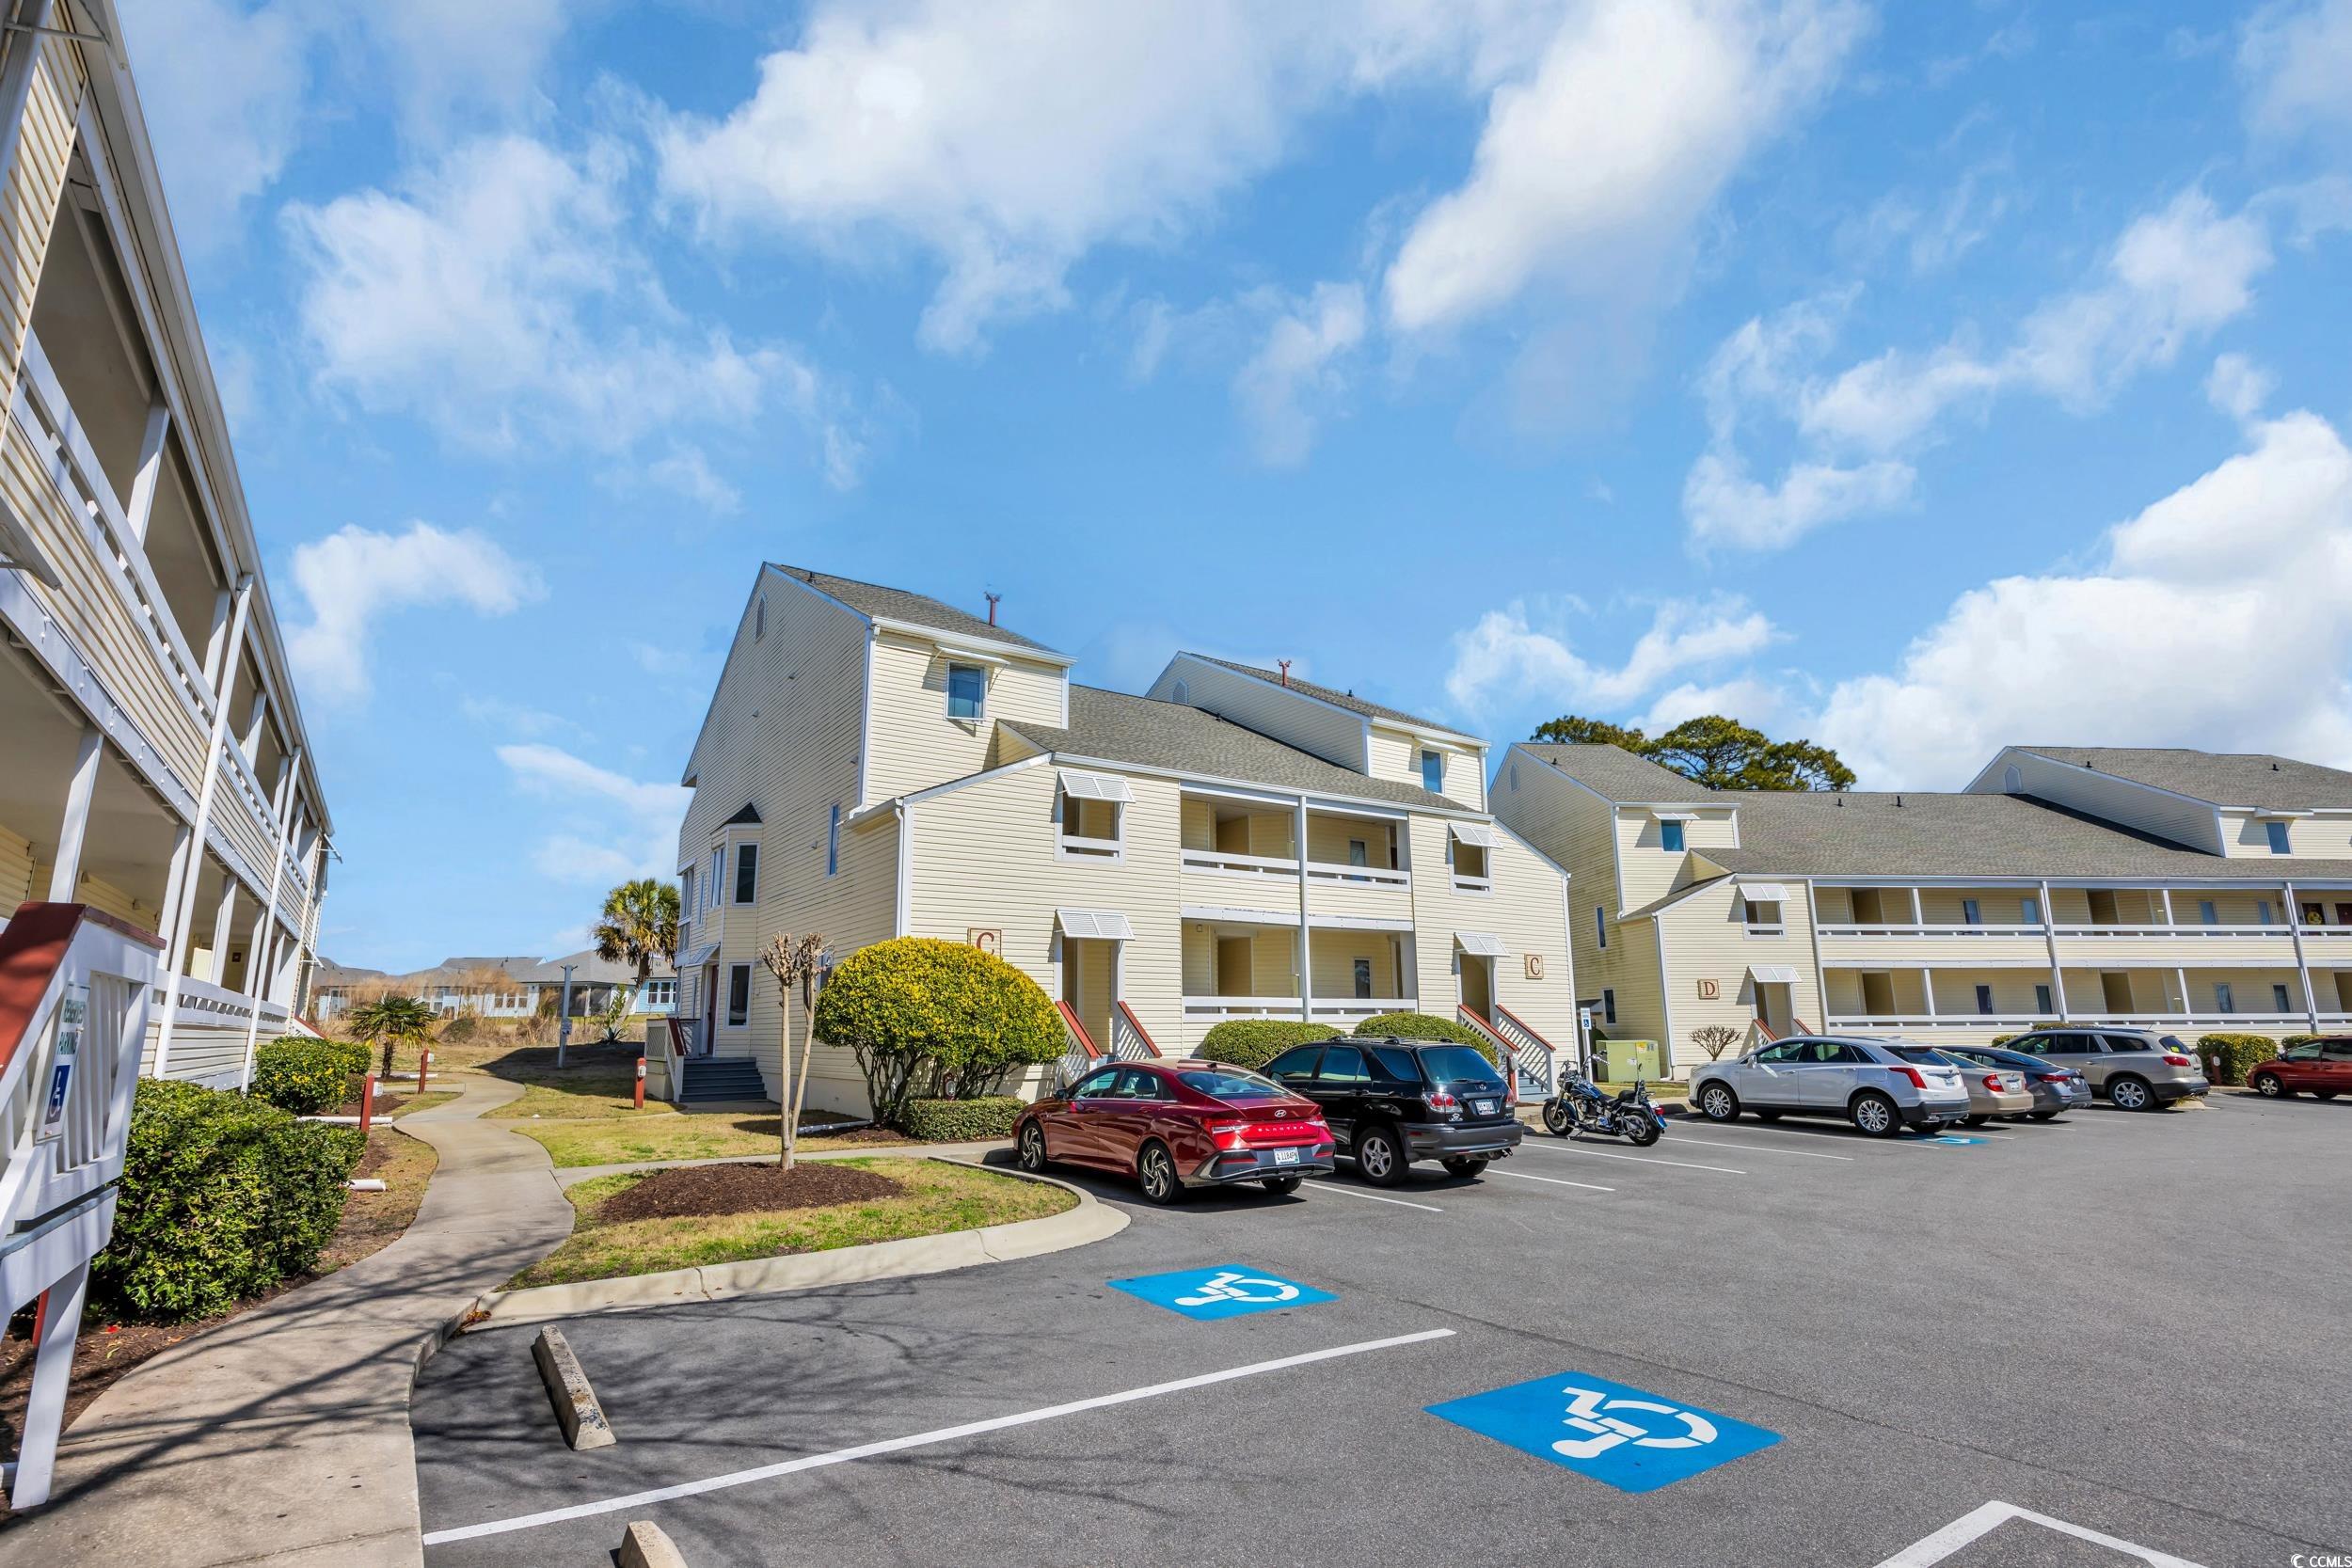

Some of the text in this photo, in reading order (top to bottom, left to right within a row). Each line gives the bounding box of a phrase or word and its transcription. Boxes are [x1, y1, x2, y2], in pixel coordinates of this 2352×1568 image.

[976, 931, 994, 956] C
[1530, 957, 1541, 975] C
[1704, 981, 1716, 996] D
